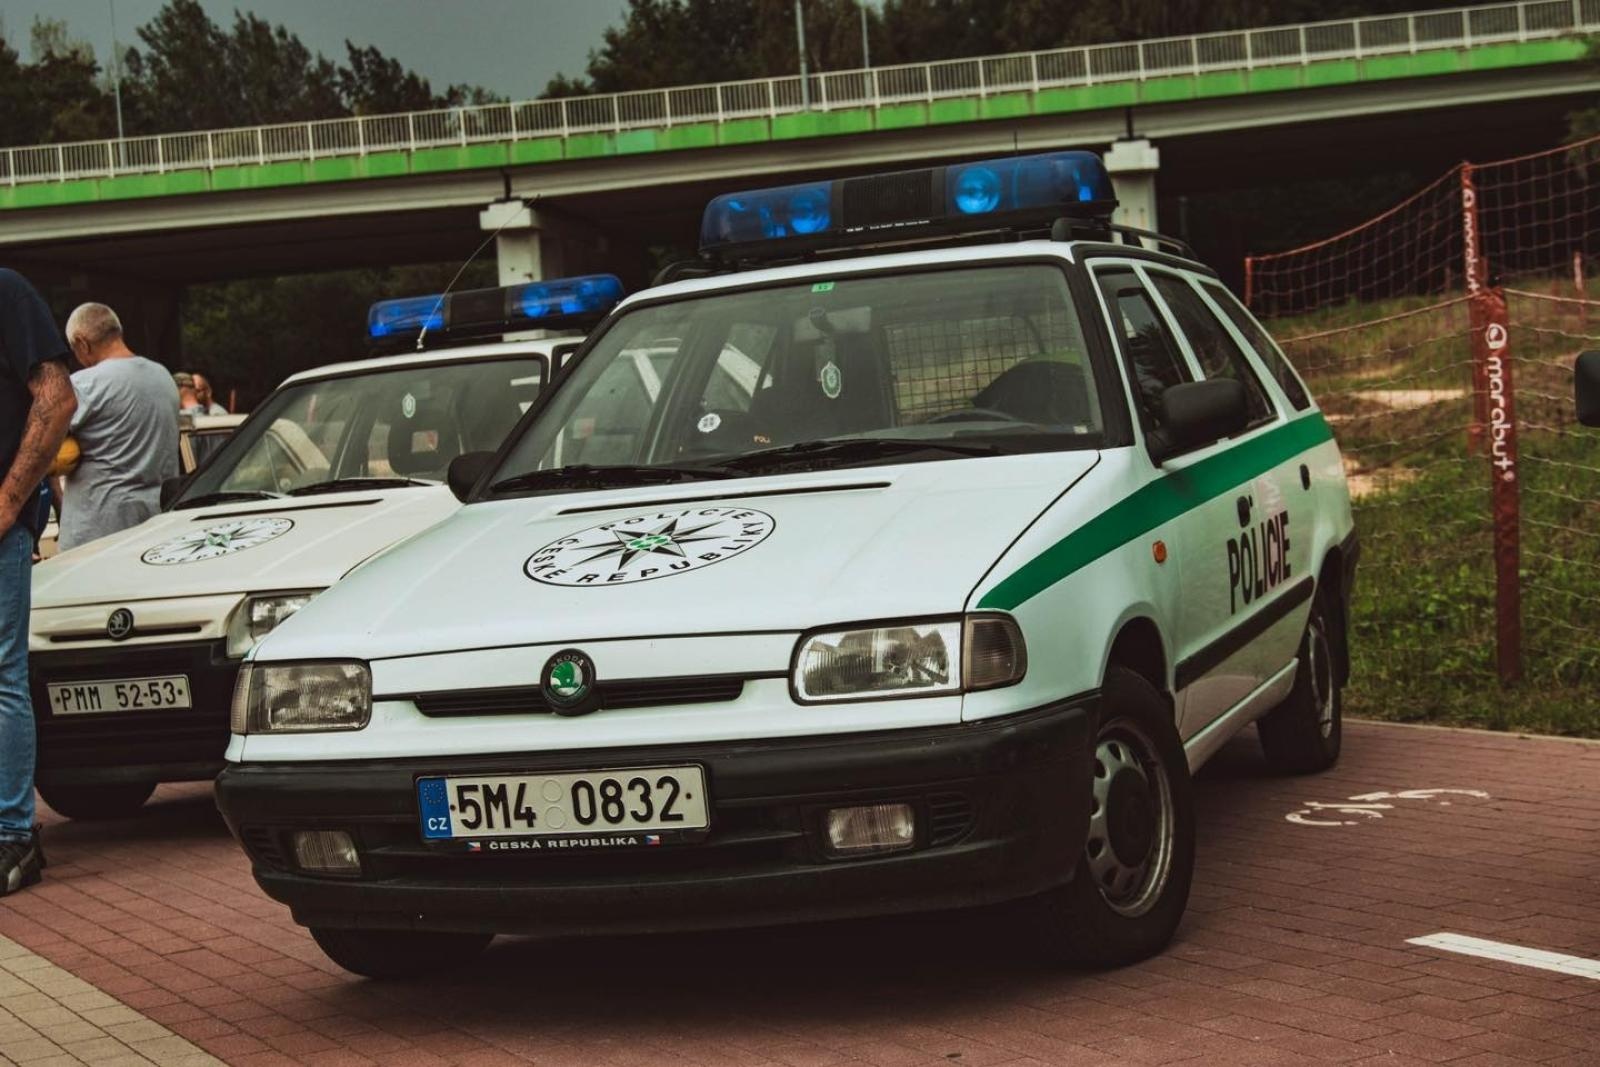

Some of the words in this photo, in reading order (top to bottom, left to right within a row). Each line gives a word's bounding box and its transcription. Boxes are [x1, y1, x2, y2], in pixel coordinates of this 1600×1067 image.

[1487, 356, 1515, 471] marabut
[599, 507, 755, 532] POLICIE
[576, 521, 764, 583] REPUBLIKY
[1226, 509, 1291, 615] POLICIE
[59, 685, 102, 712] PMM
[456, 782, 537, 830] 5M4
[570, 775, 685, 826] 0832
[427, 817, 448, 831] CZ
[489, 838, 541, 850] ČESKÁ
[547, 836, 638, 849] REPUBLIKA
